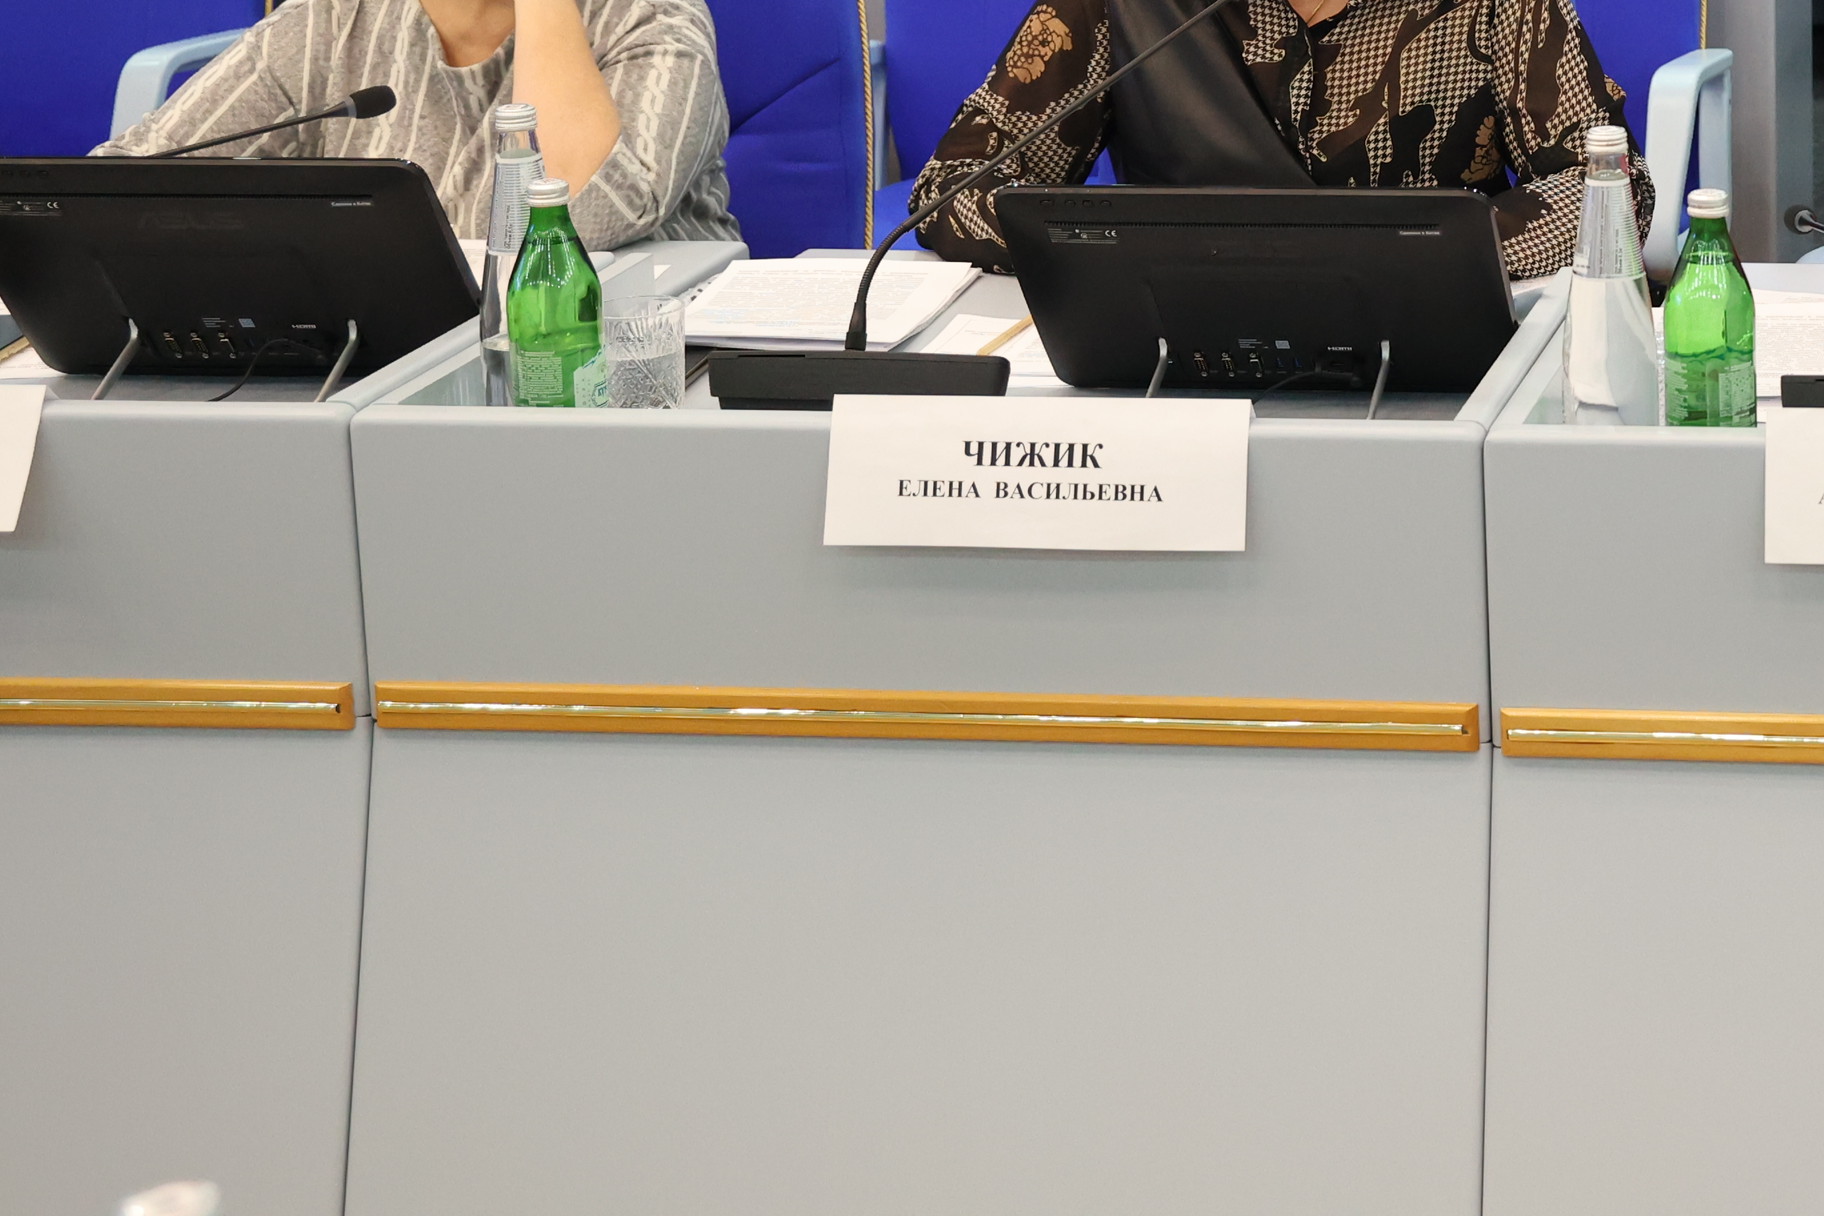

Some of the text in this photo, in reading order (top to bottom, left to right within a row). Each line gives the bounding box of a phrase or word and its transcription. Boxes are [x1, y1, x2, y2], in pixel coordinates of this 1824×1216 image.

[962, 439, 1105, 470] ЧИЖИК
[897, 479, 1164, 503] ЕЛЕНА ВАСИЛЬЕВНА
